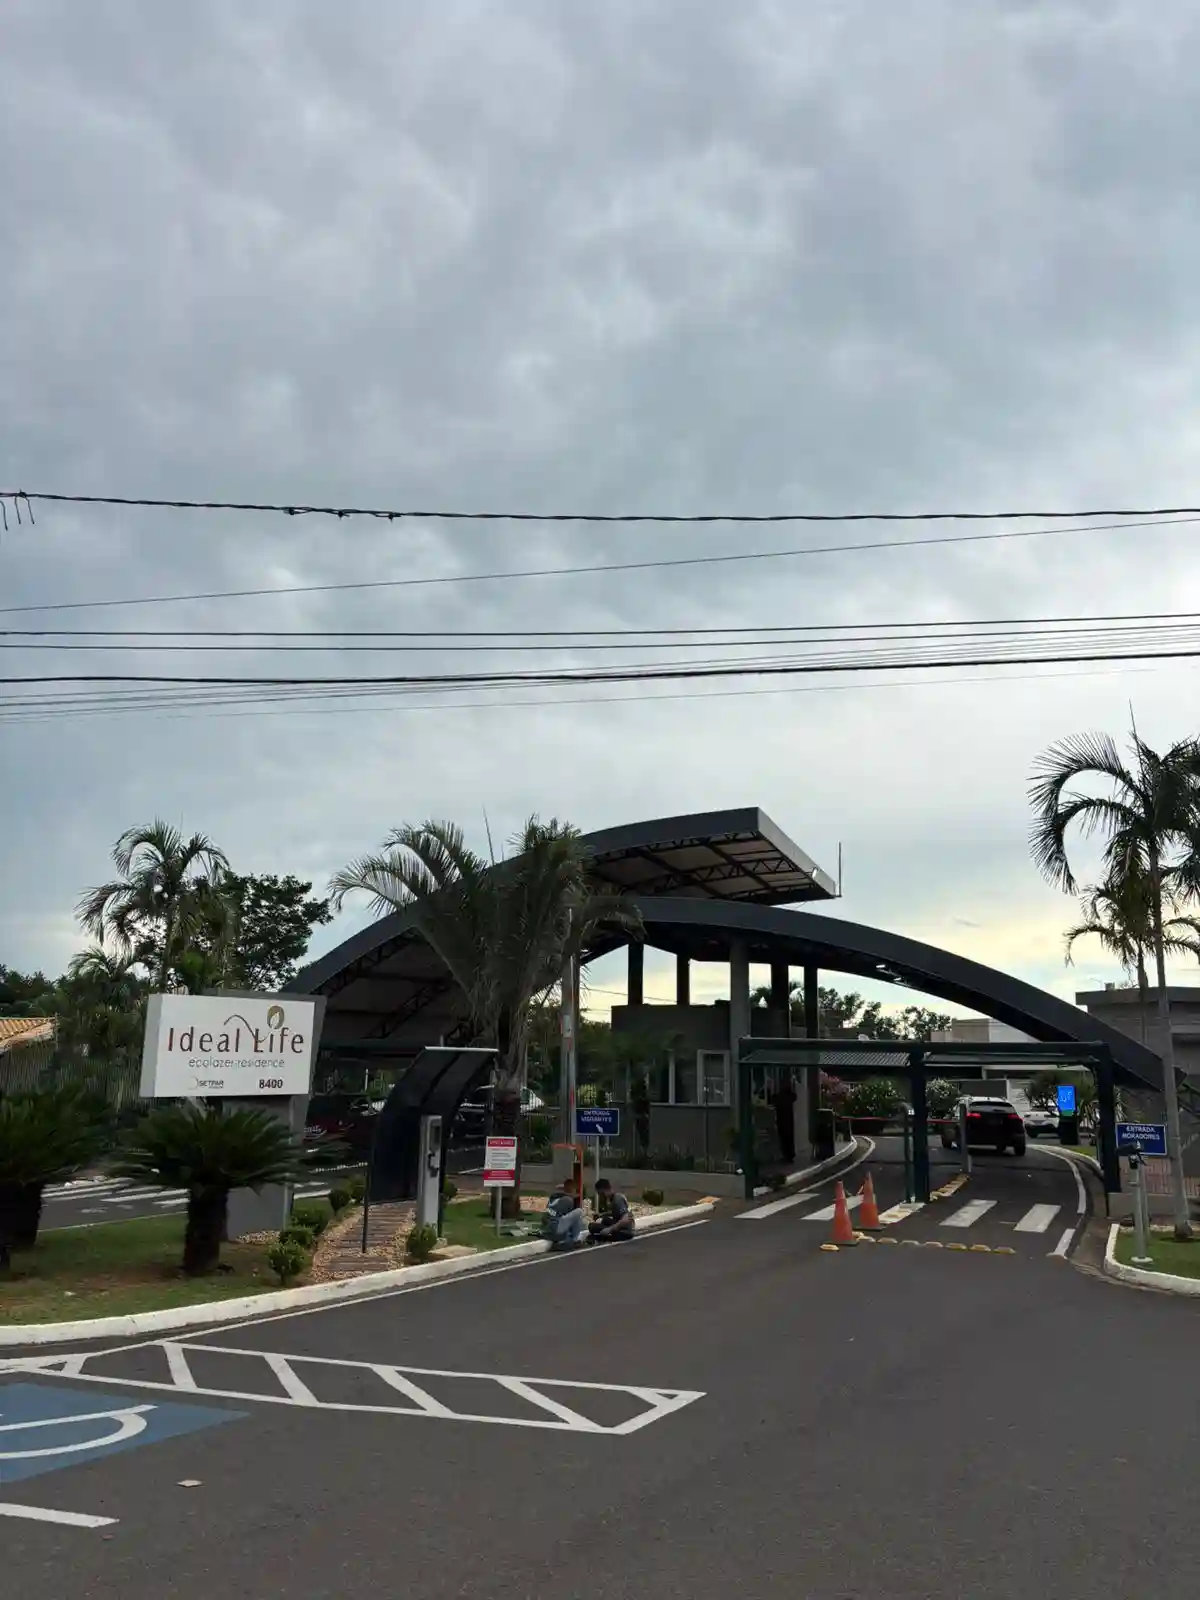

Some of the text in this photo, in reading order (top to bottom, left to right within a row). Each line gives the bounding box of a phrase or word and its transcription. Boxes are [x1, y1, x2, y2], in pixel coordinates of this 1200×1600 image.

[167, 1026, 304, 1054] Ideal Life
[258, 1078, 283, 1089] 8400
